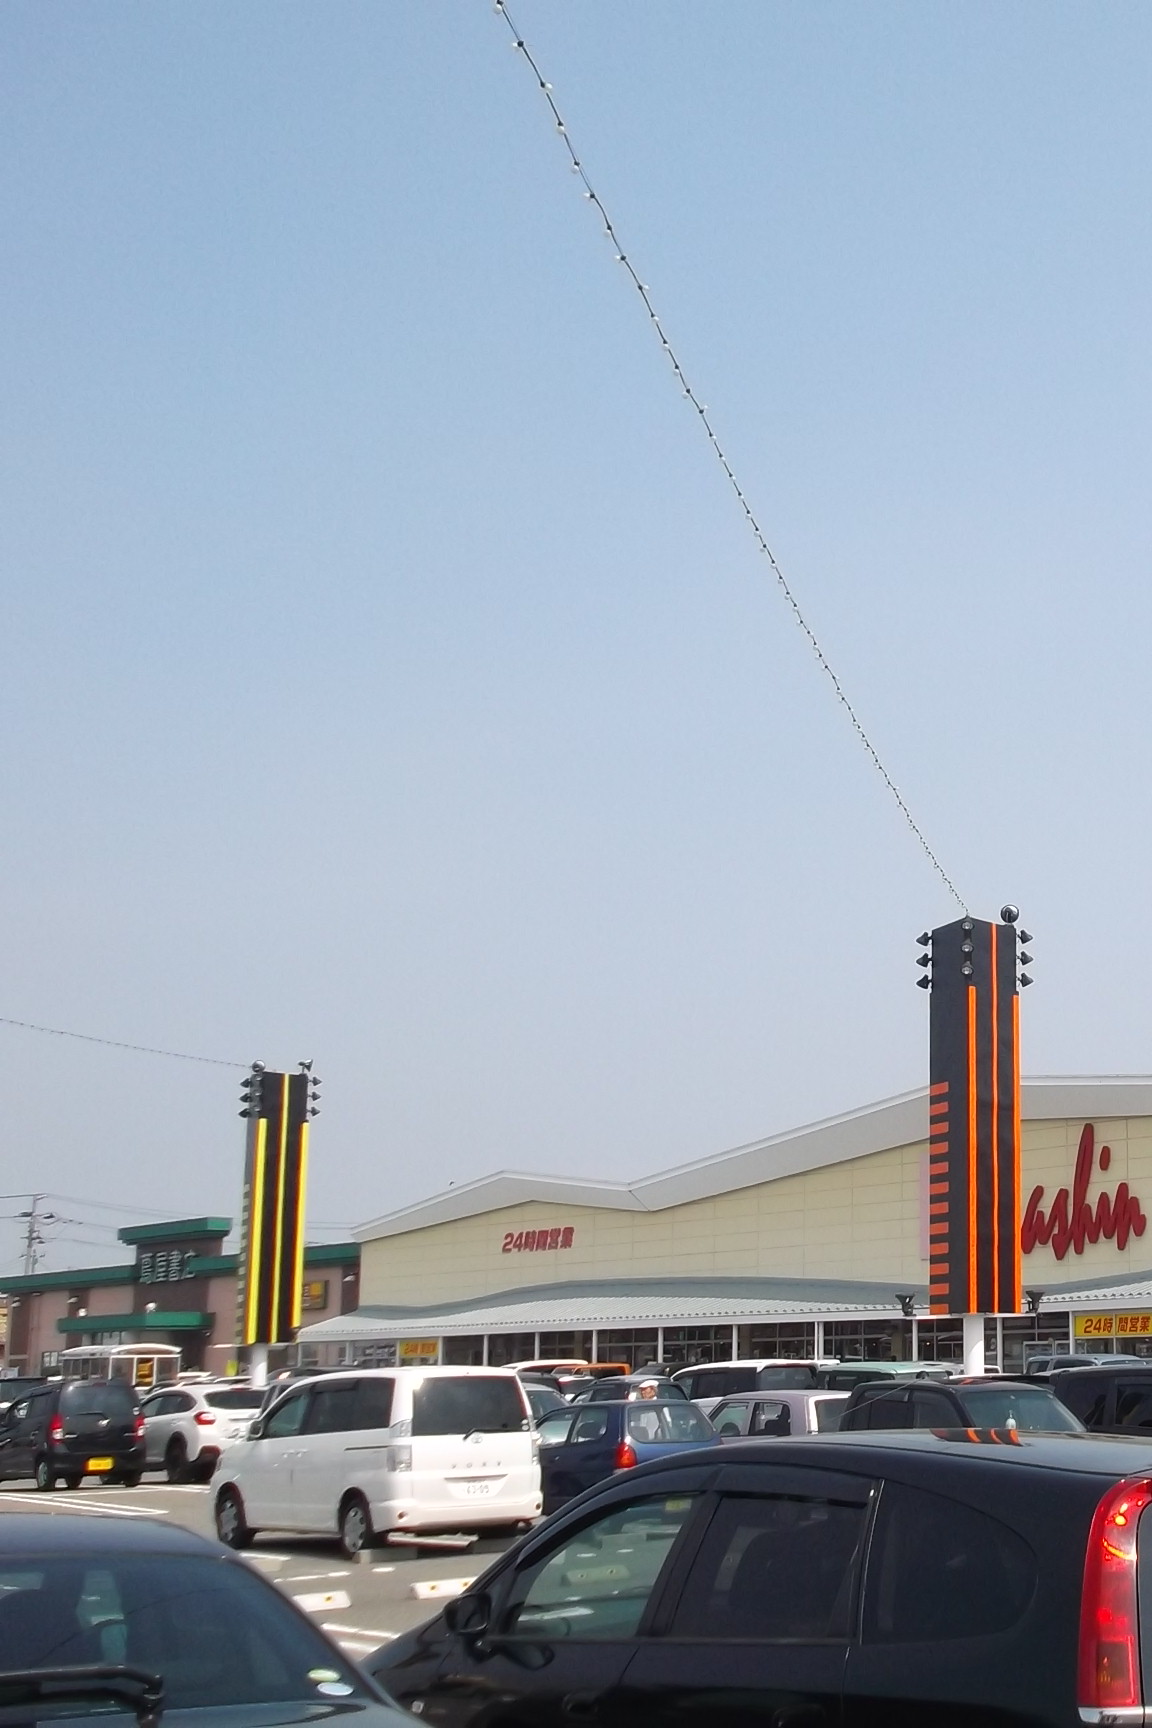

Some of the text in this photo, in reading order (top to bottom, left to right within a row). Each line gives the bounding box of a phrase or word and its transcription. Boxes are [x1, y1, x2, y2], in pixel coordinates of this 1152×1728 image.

[1021, 1122, 1147, 1261] ashin
[502, 1226, 574, 1253] 24時間営業
[1083, 1316, 1151, 1334] 24時間営業
